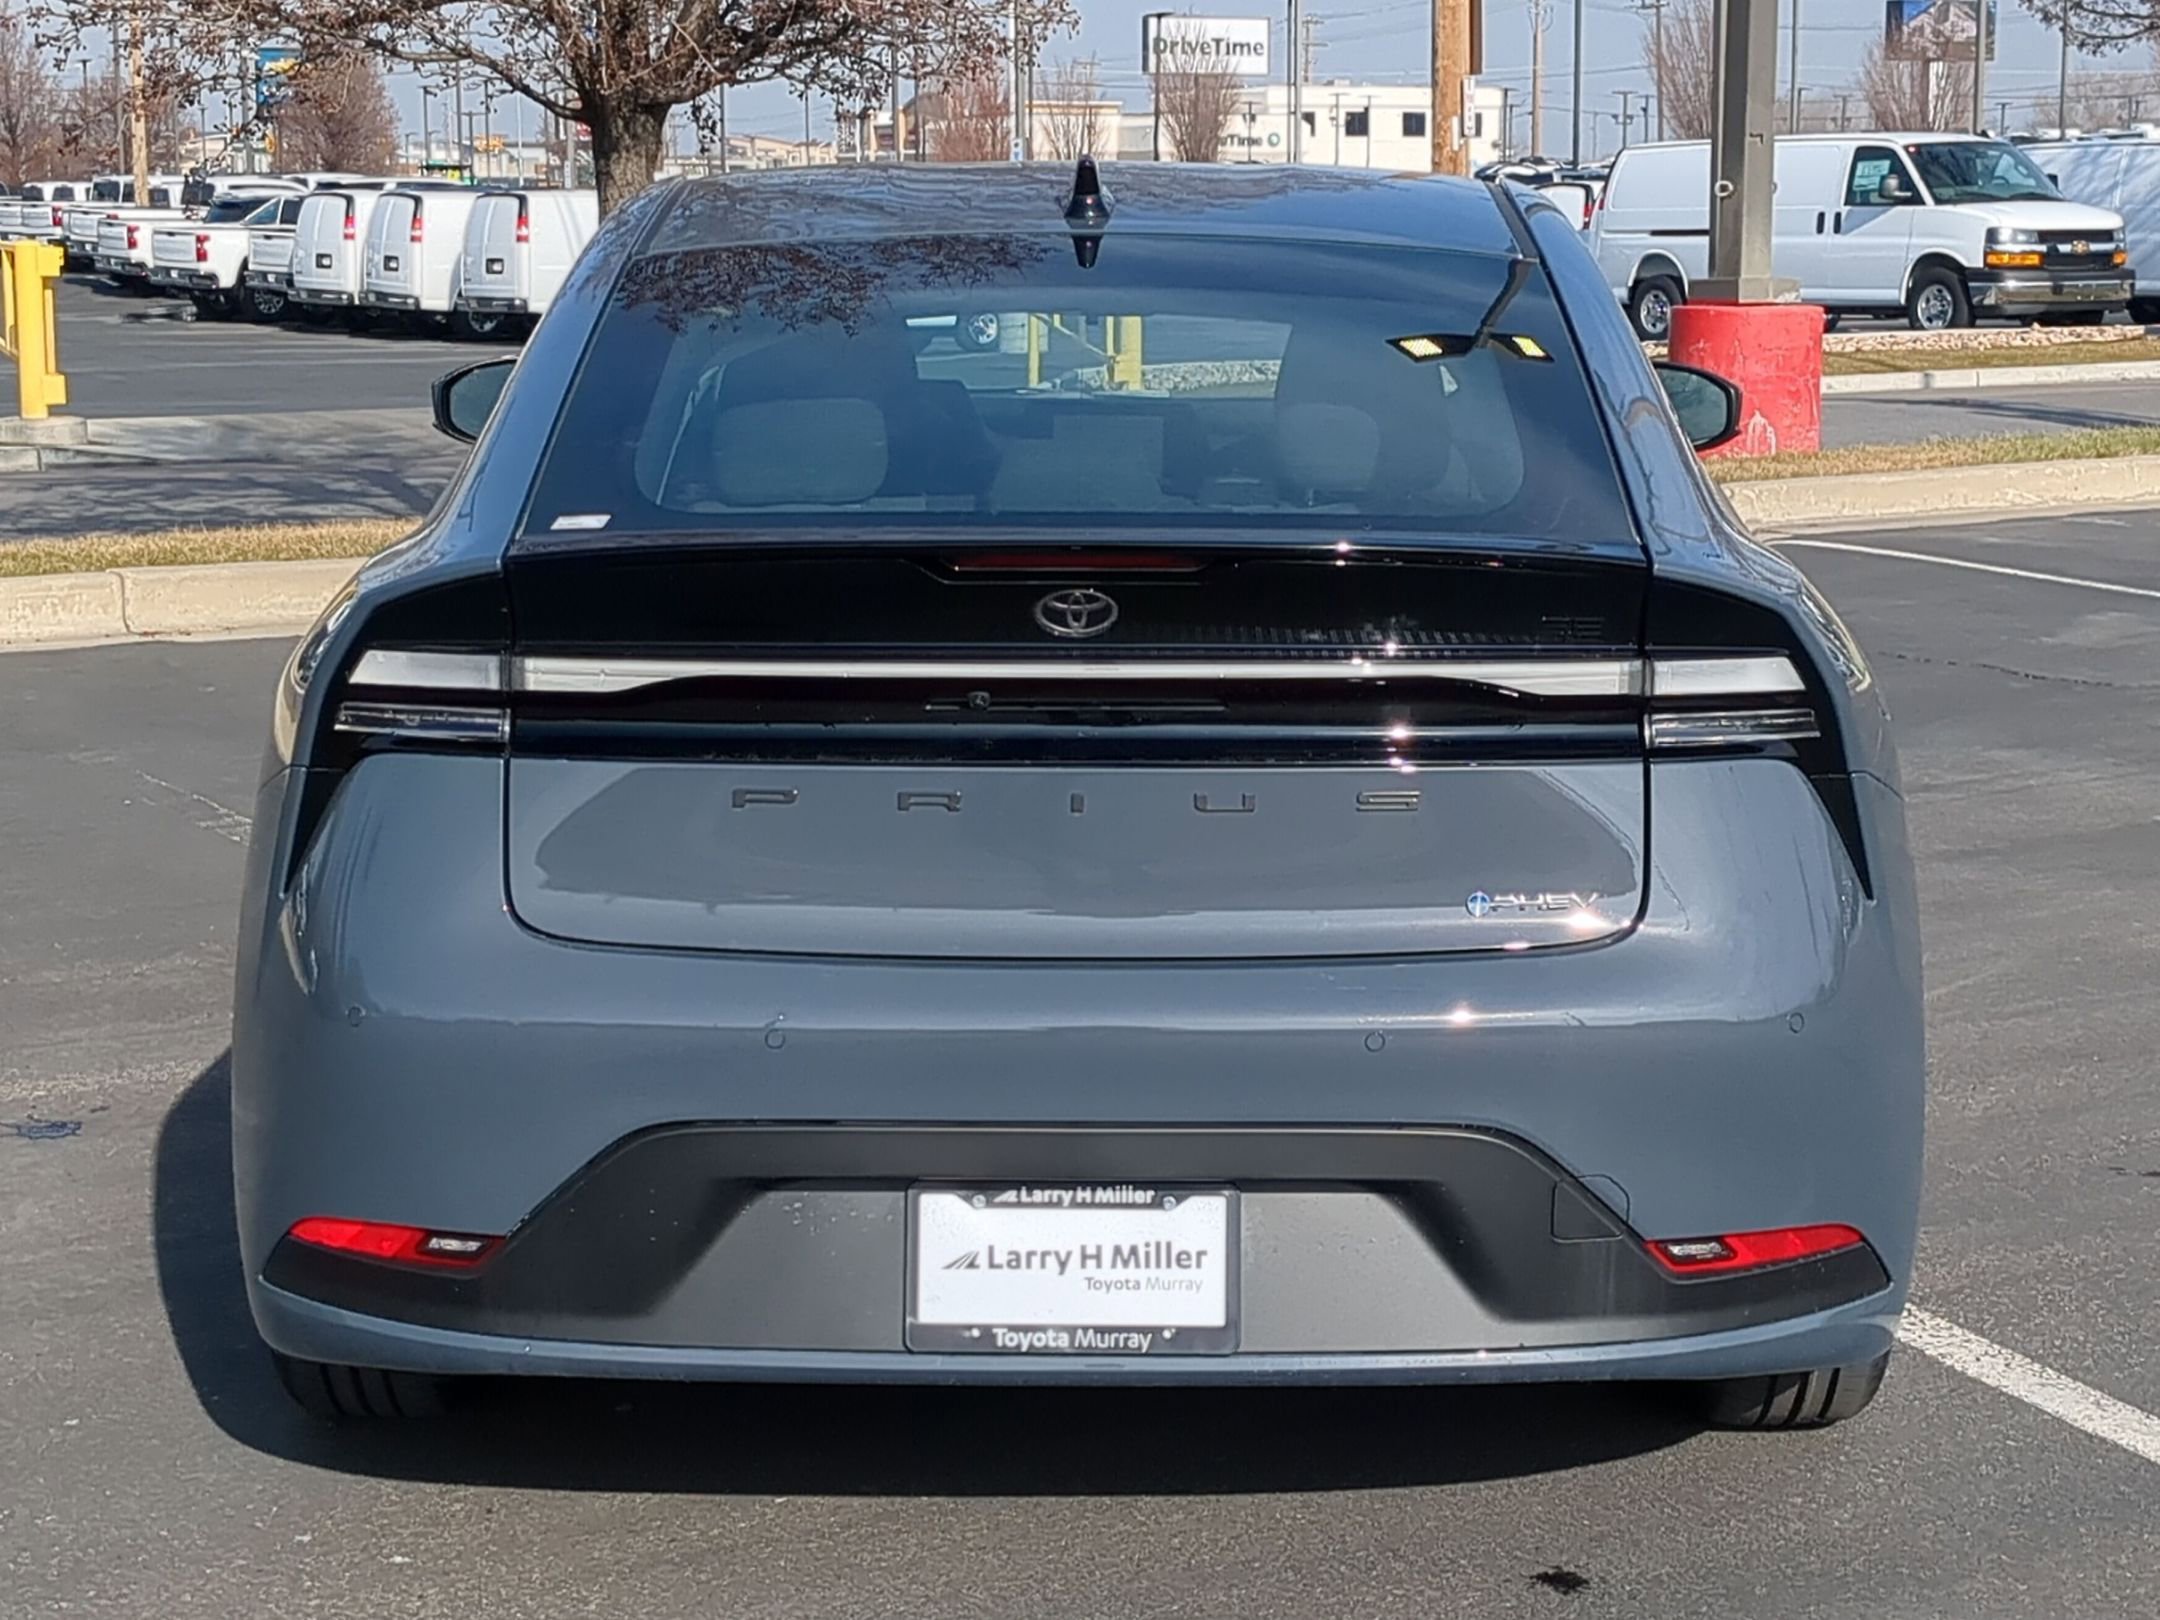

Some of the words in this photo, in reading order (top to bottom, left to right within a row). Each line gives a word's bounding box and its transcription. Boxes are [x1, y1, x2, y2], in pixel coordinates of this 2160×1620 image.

[1153, 36, 1264, 56] DriveTime
[731, 787, 1421, 812] PRIUS
[1020, 1186, 1073, 1207] Larry
[1076, 1187, 1091, 1204] H
[1094, 1185, 1155, 1204] Miller
[988, 1244, 1073, 1275] Larry
[1080, 1244, 1103, 1270] H
[1110, 1241, 1208, 1270] Miller
[1085, 1276, 1141, 1292] Toyota
[1145, 1276, 1204, 1293] Murray
[992, 1327, 1070, 1352] Toyota
[1074, 1329, 1153, 1353] Murray
